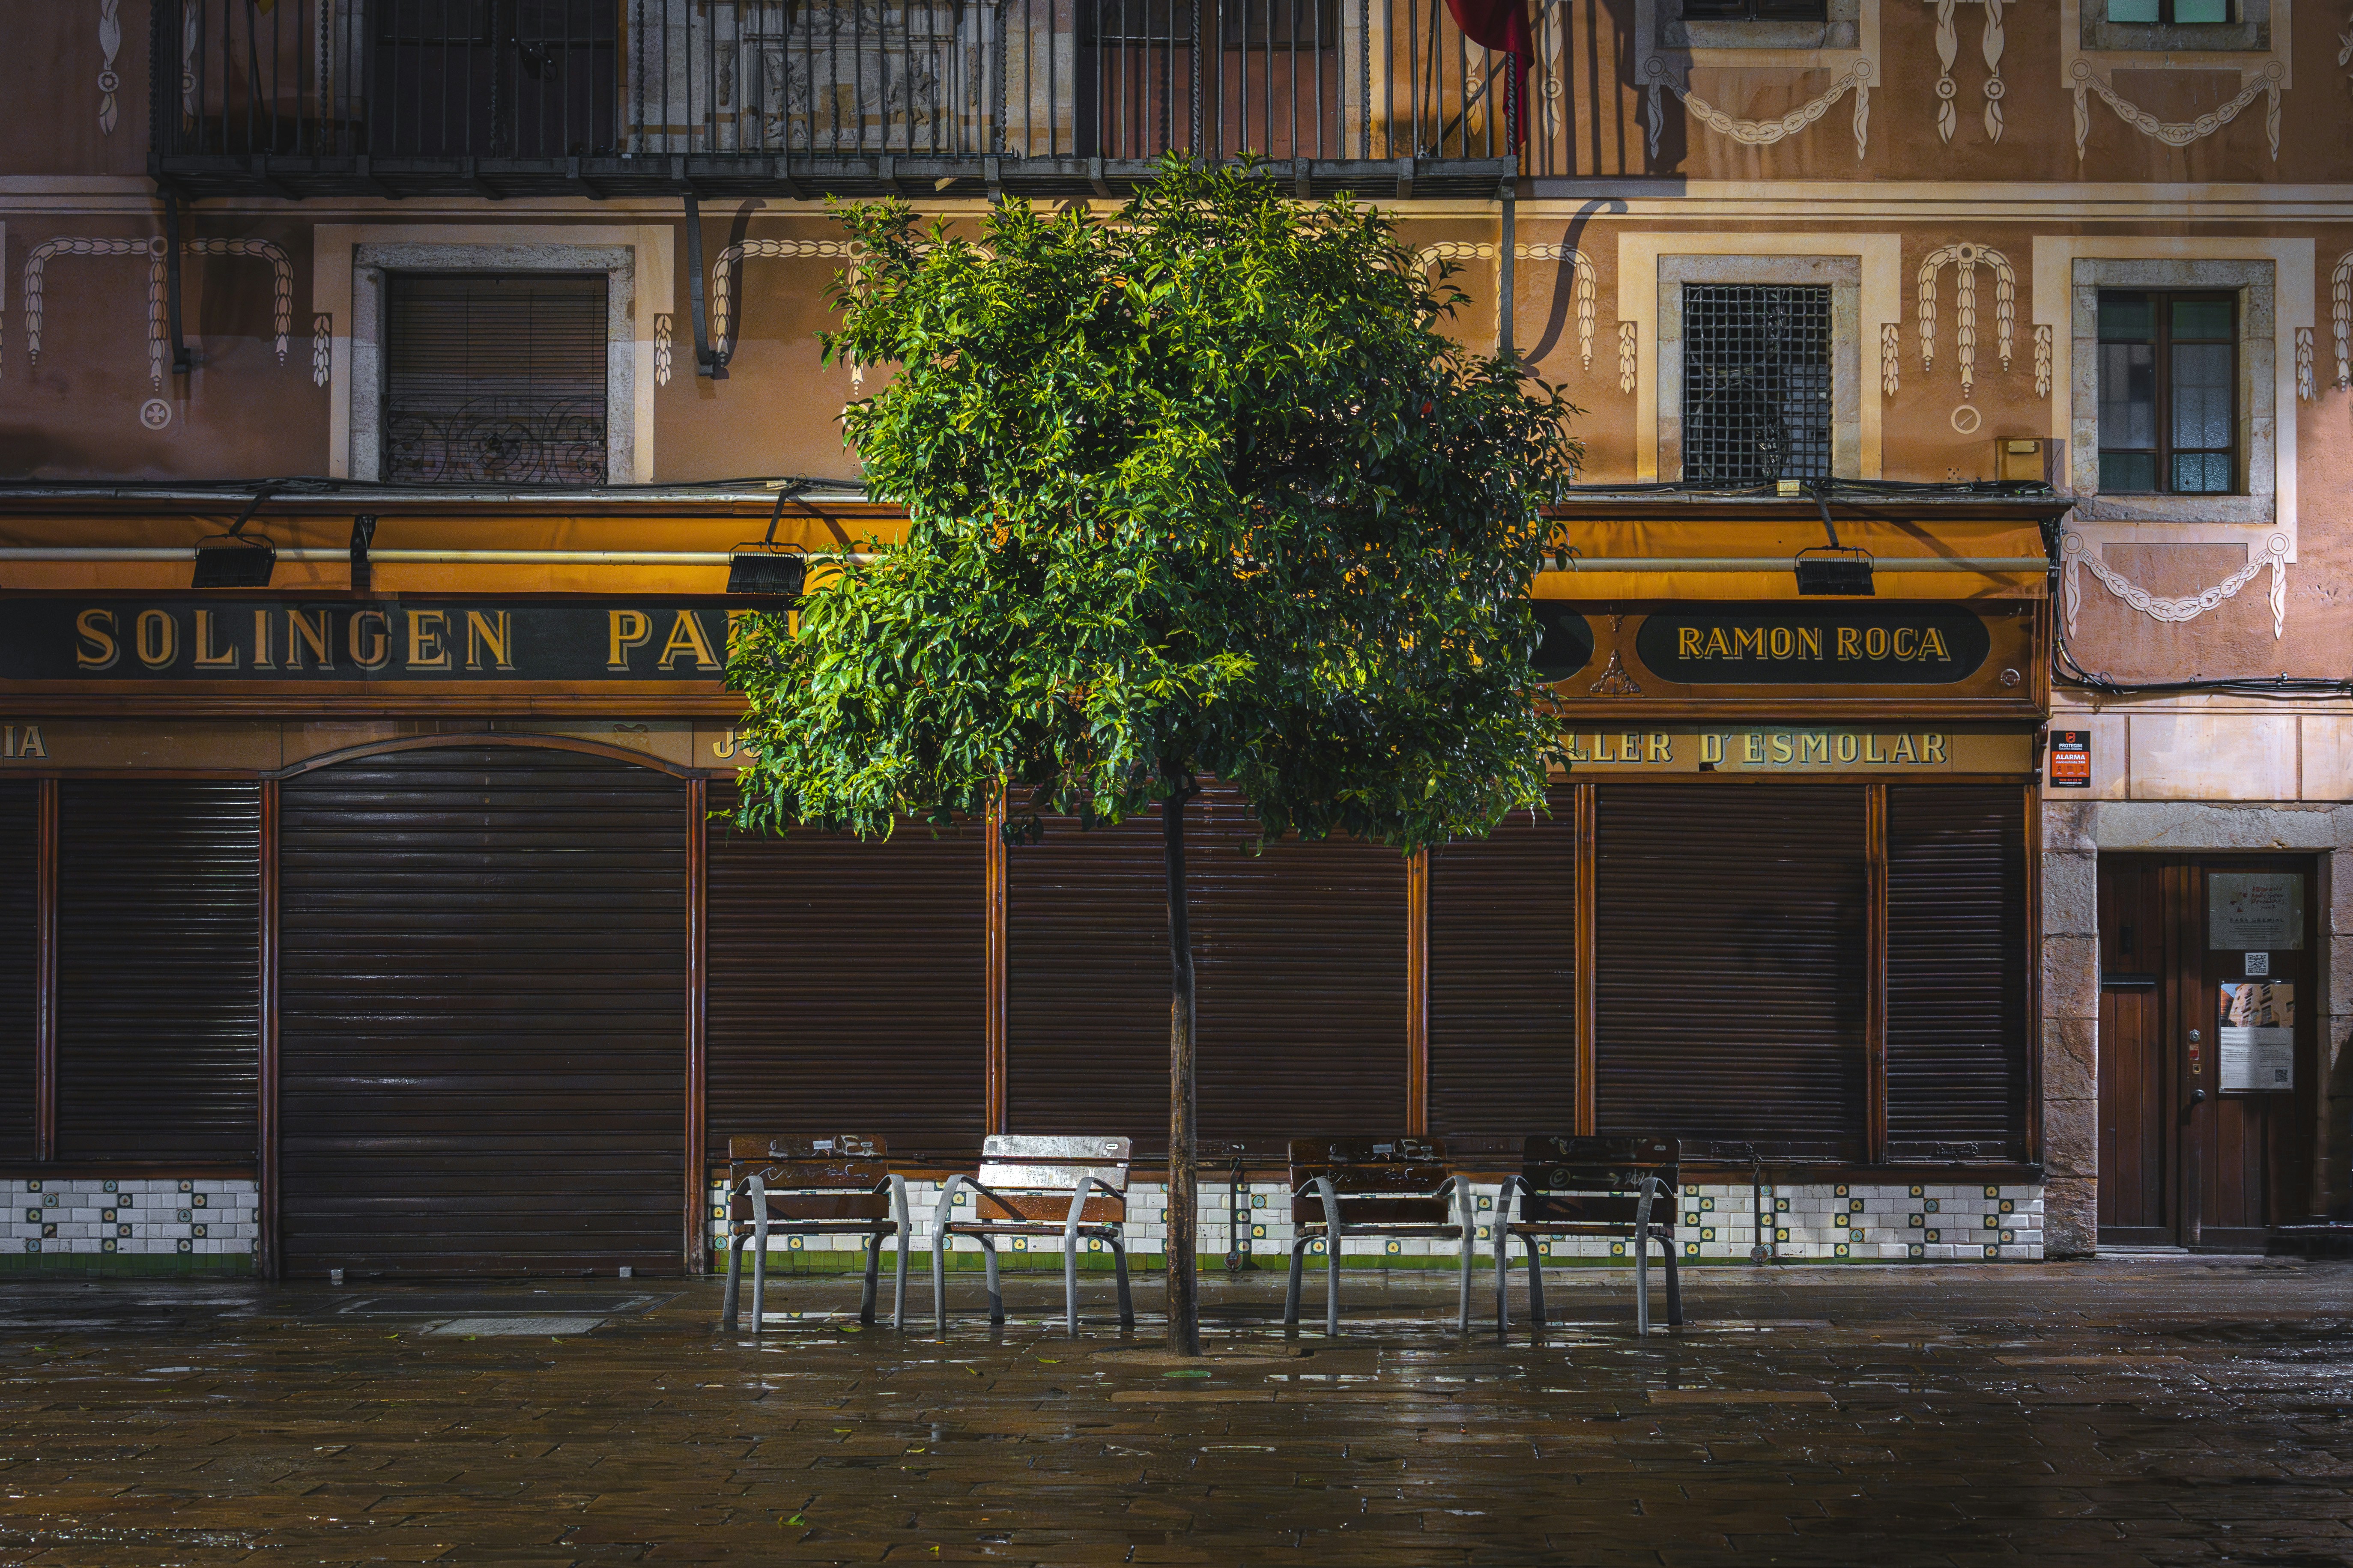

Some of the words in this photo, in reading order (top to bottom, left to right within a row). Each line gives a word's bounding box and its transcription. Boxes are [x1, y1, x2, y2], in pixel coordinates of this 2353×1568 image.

[76, 608, 516, 671] SOLINGEN
[1678, 627, 1824, 660] RAMON
[1836, 627, 1952, 662] ROCA
[1700, 732, 1947, 765] D'ESMOLAR
